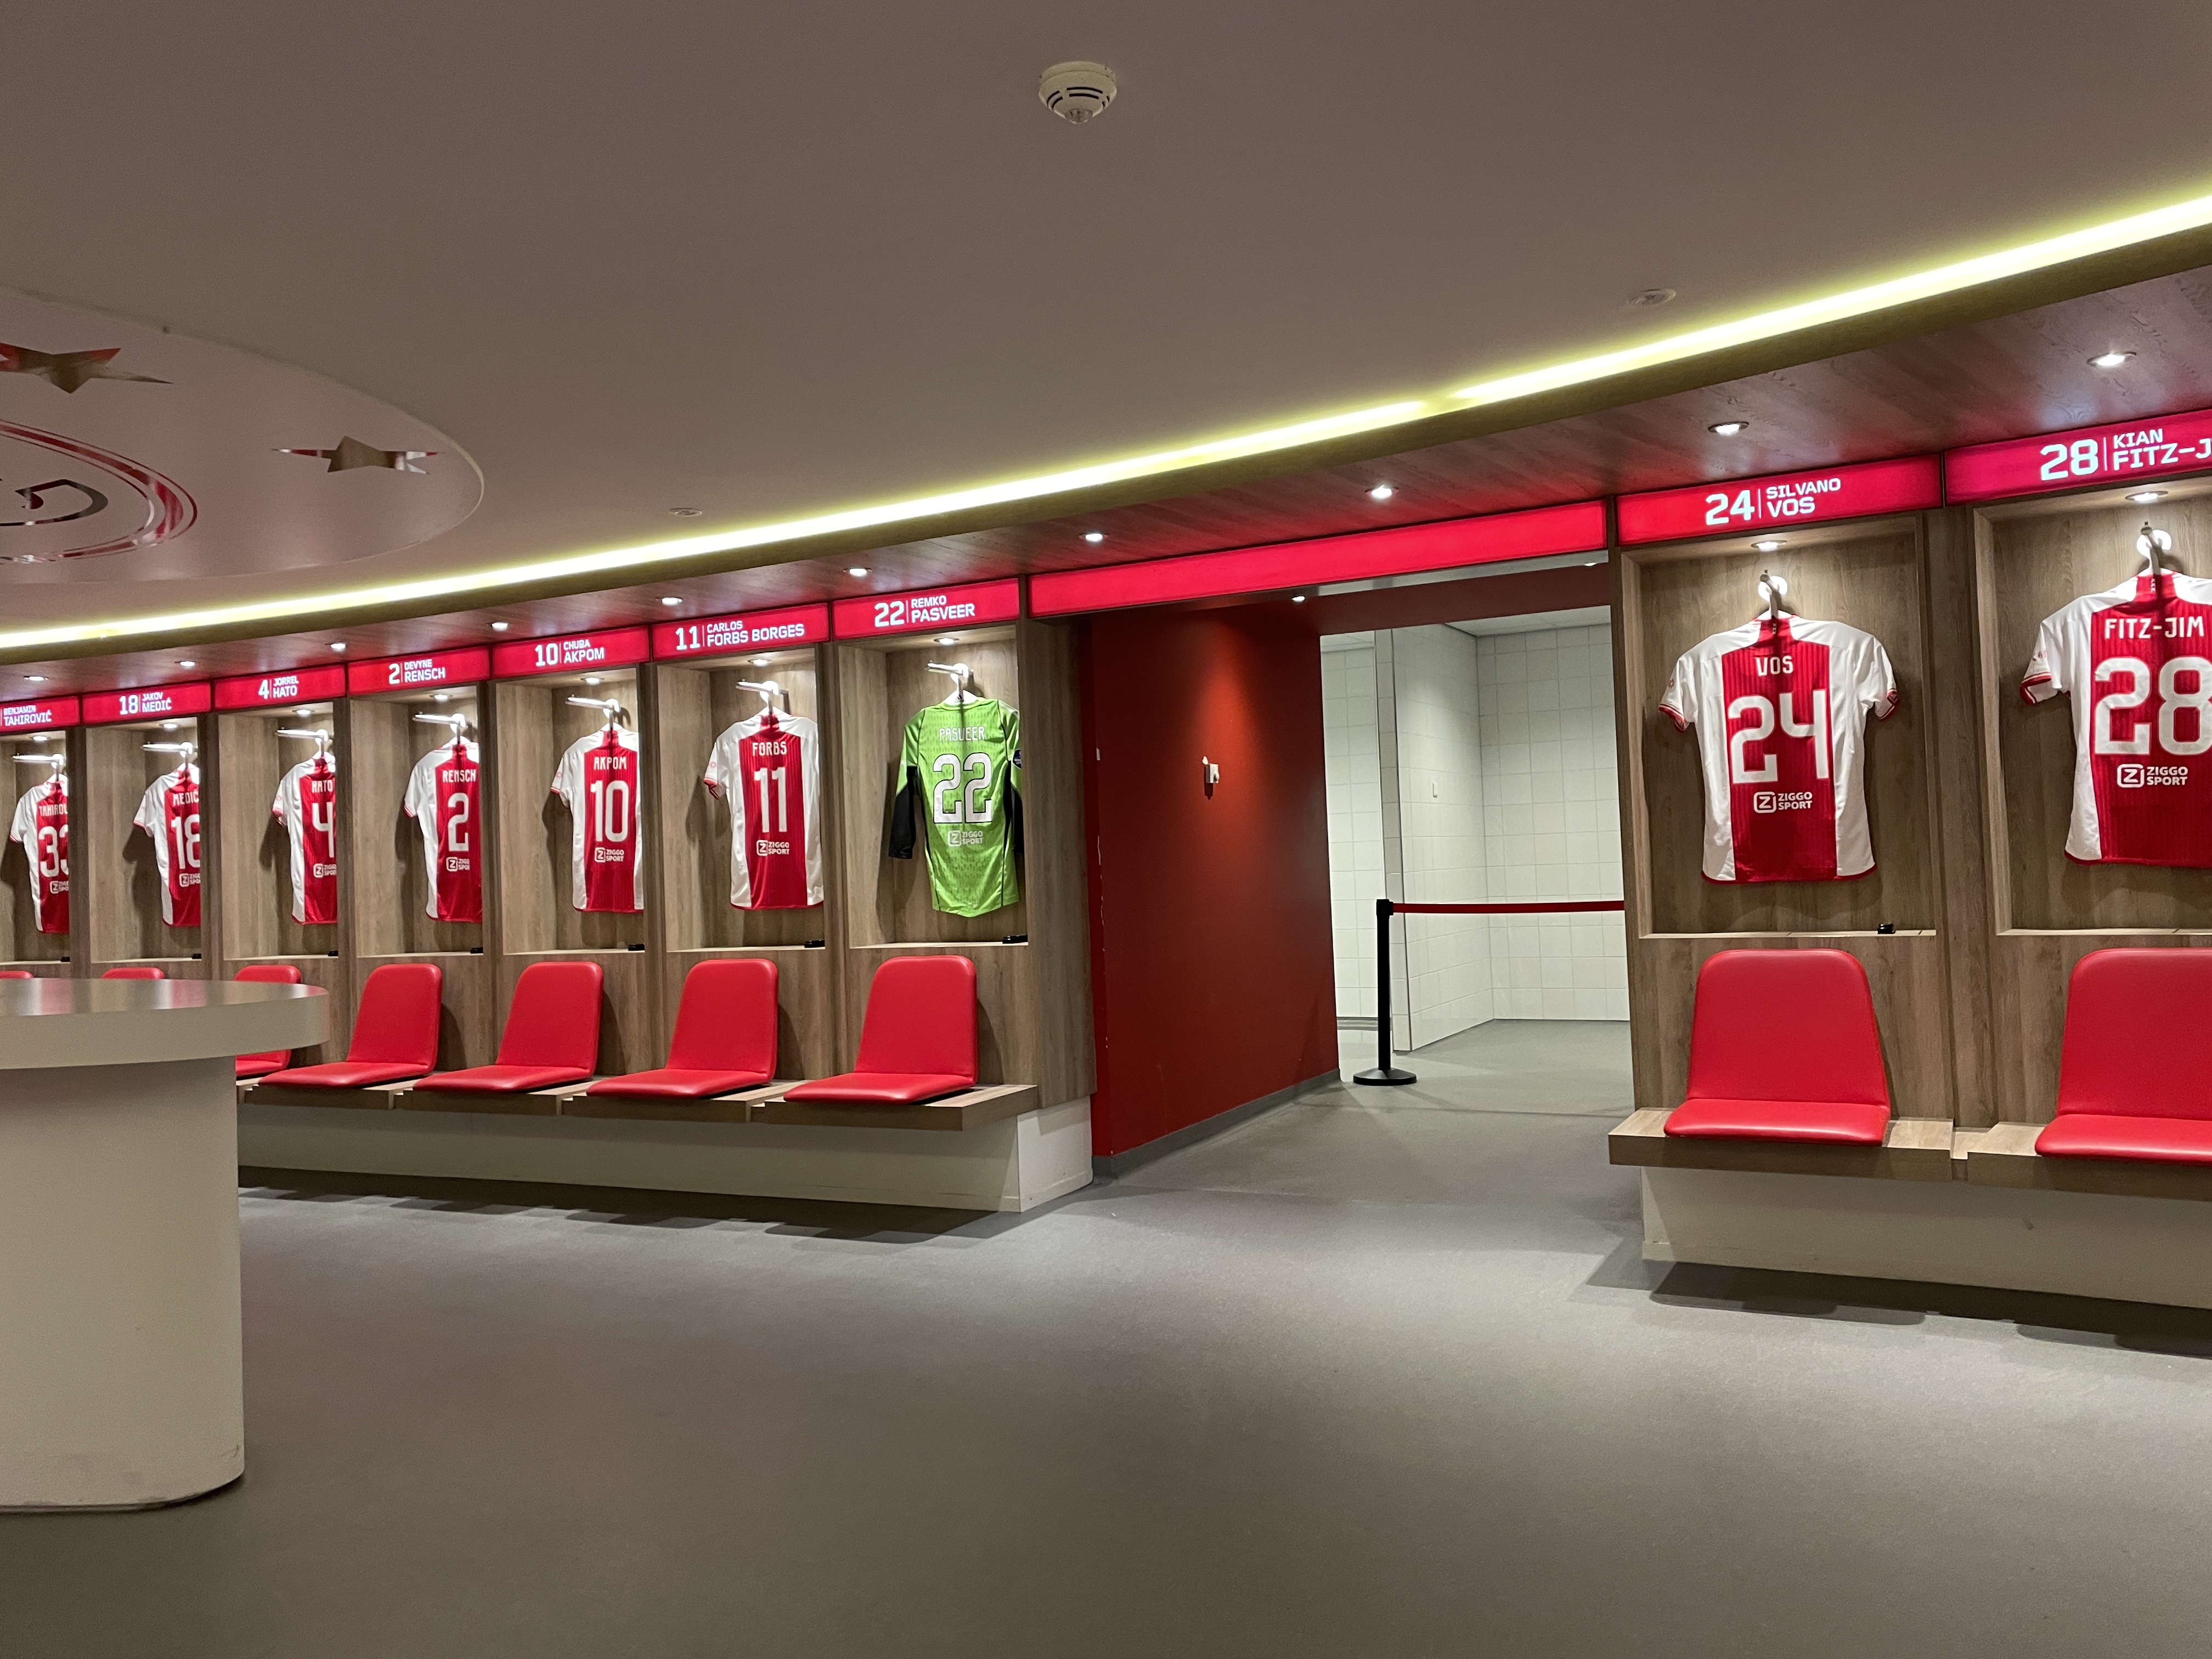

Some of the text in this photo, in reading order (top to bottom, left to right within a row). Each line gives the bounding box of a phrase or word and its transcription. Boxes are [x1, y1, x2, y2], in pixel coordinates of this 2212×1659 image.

[2114, 428, 2163, 449] KIAN
[2040, 438, 2098, 481] 28
[2113, 438, 2212, 471] FITZ-J
[1766, 477, 1841, 499] SILVANO
[1706, 489, 1755, 526] 24
[1767, 496, 1815, 518] VOS
[911, 595, 947, 608] REMKO
[874, 600, 905, 627] 22
[911, 603, 975, 623] PASVEER
[707, 620, 743, 633] CARLOS
[707, 624, 805, 647] FORBS BORGES
[2105, 616, 2204, 639] FITZ-JIM
[563, 639, 590, 651] CHUBA
[675, 625, 700, 650] 11
[404, 659, 432, 670] DEVYNE
[535, 643, 558, 666] 10
[563, 647, 605, 663] AKPOM
[389, 663, 400, 684] 2
[404, 667, 445, 682] RENSCH
[1754, 655, 1793, 676] VOS
[258, 679, 269, 699] 4
[273, 675, 299, 686] JORREL
[142, 692, 163, 701] JAKOV
[273, 685, 297, 698] HATO
[3, 705, 36, 715] BENJAMIN
[119, 695, 138, 715] 18
[142, 697, 172, 712] MEDIĆ
[2095, 657, 2212, 755] 28
[3, 709, 52, 726] TAHIROVIĆ
[939, 726, 986, 742] PASVEER
[1729, 689, 1829, 783] 24
[752, 741, 787, 757] FORBS
[594, 756, 627, 770] AKPOM
[2147, 766, 2188, 776] ZIGGO
[443, 769, 476, 782] RENSCH
[2147, 776, 2187, 786] SPORT
[312, 780, 333, 793] HATO
[933, 752, 992, 824] 22
[1778, 792, 1813, 801] ZIGGO
[754, 766, 787, 833] 11
[1778, 800, 1813, 810] SPORT
[590, 780, 629, 842] 10
[312, 802, 334, 858] 4
[448, 792, 469, 851] 2
[171, 814, 200, 870] 18
